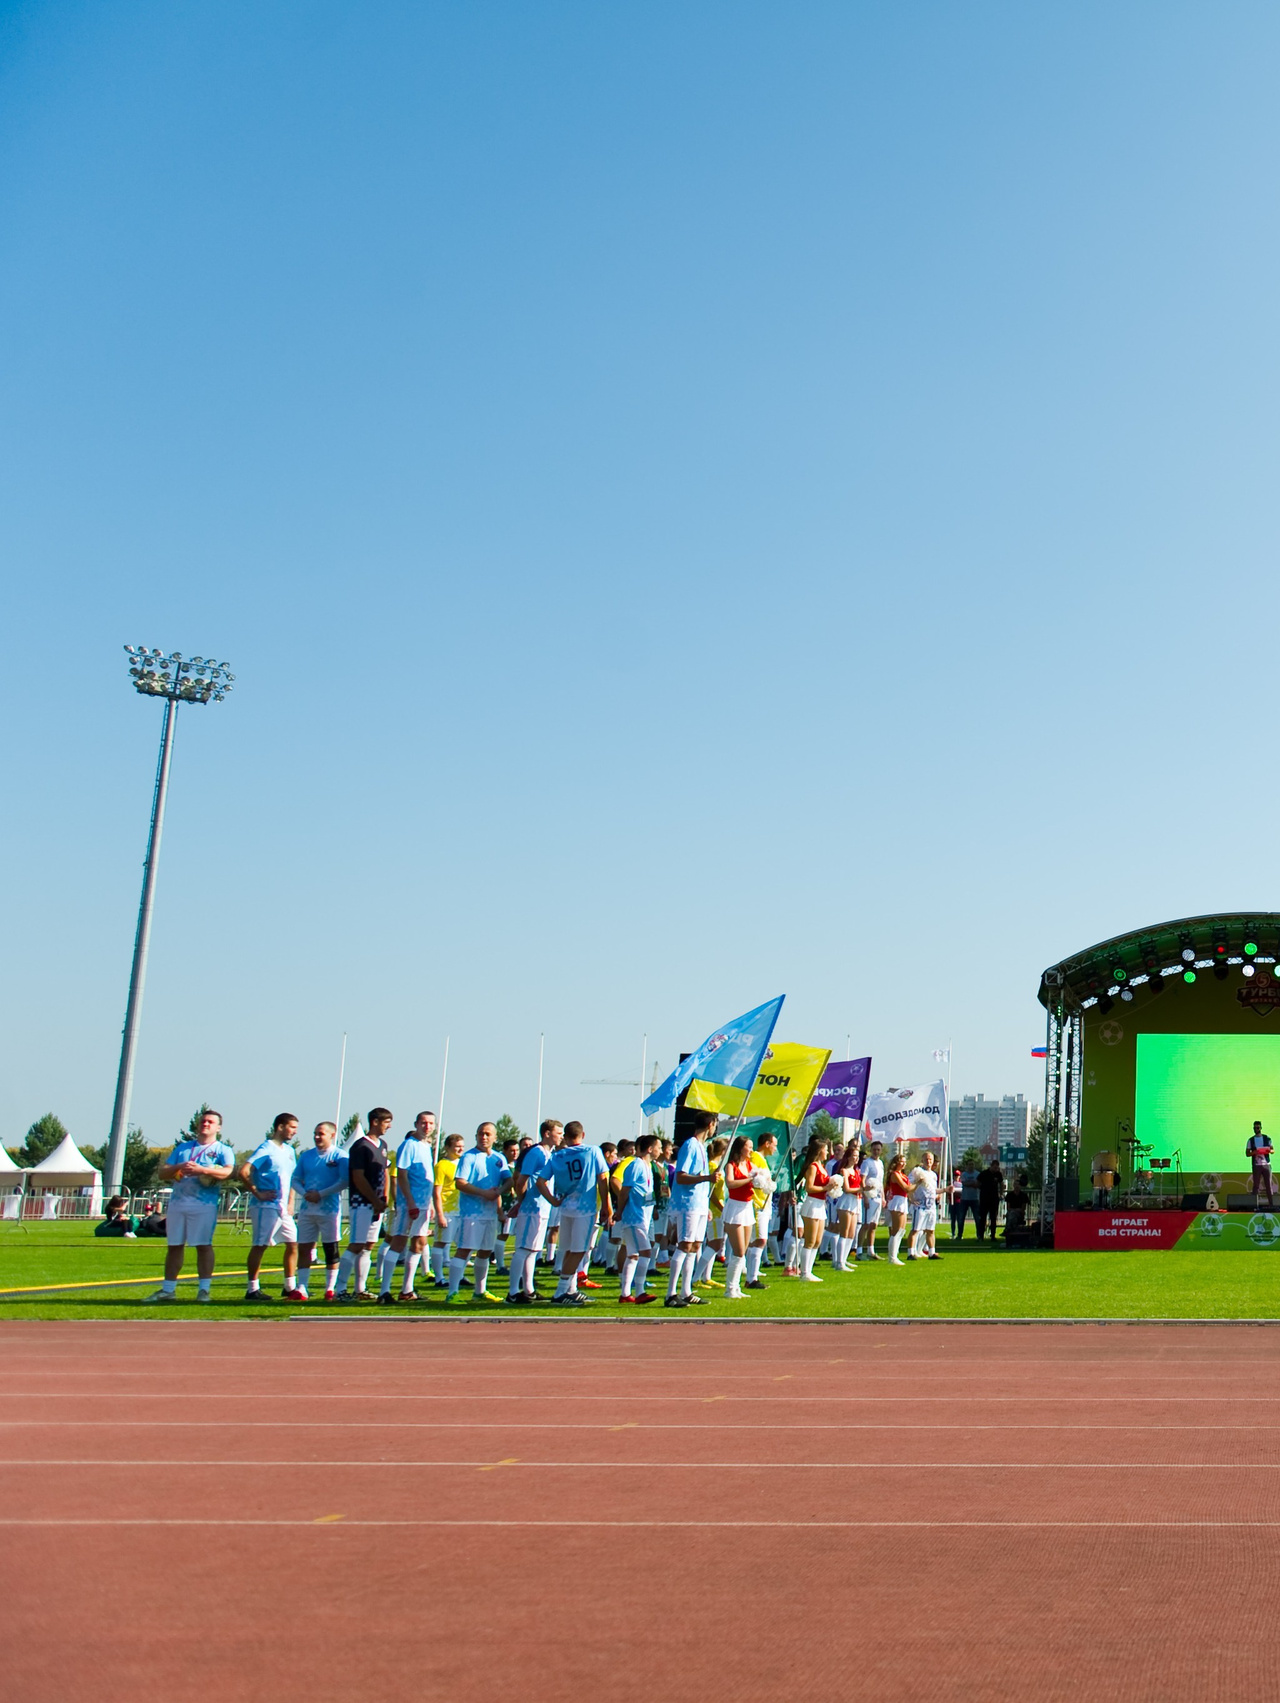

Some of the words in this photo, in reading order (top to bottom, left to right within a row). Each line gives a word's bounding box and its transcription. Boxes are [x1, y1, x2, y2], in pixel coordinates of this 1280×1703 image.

[565, 1158, 584, 1182] 19
[1111, 1218, 1149, 1226] ИГРАЕТ
[1098, 1229, 1118, 1237] ВСЯ
[1119, 1229, 1162, 1237] СТРАНА!
